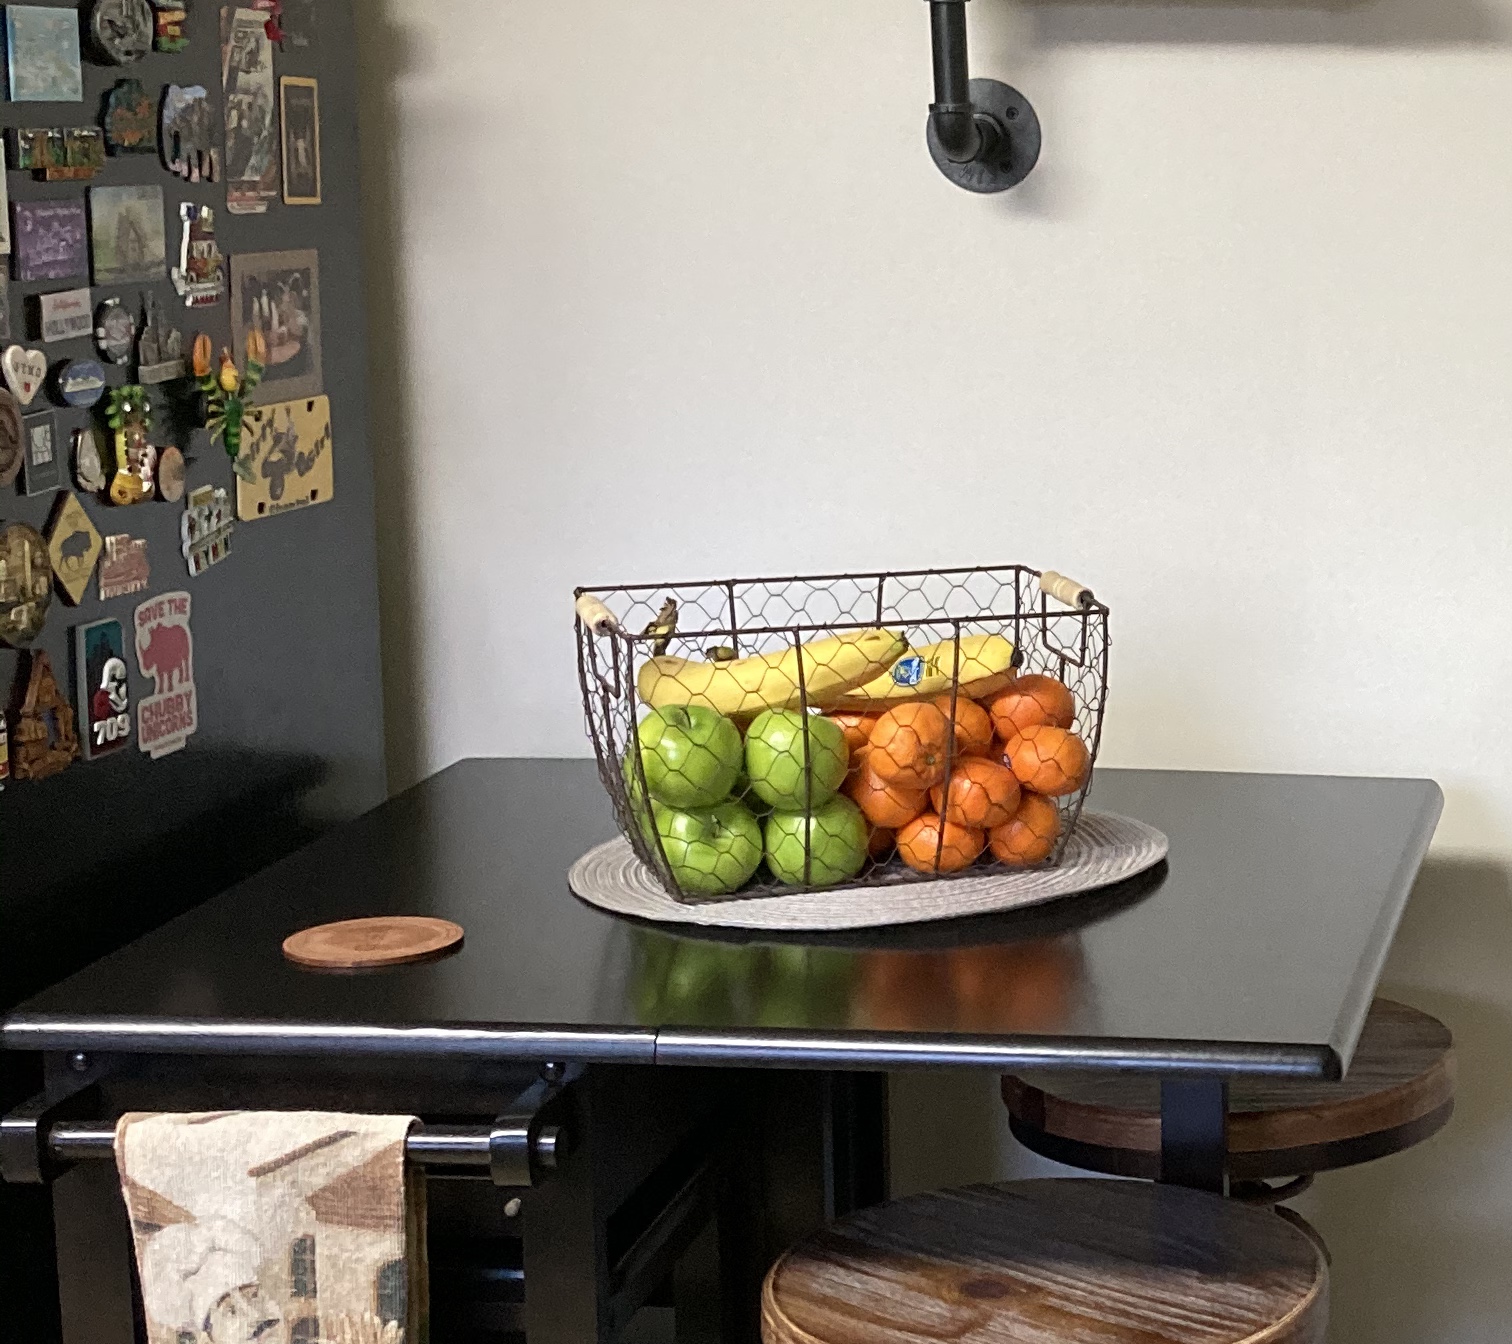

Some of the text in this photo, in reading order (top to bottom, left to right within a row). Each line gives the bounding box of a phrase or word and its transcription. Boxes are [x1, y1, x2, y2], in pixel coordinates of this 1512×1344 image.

[138, 598, 189, 627] SAVE THE
[141, 689, 193, 726] CHUBBY
[94, 713, 131, 746] 709
[142, 711, 194, 746] UNICORNS
